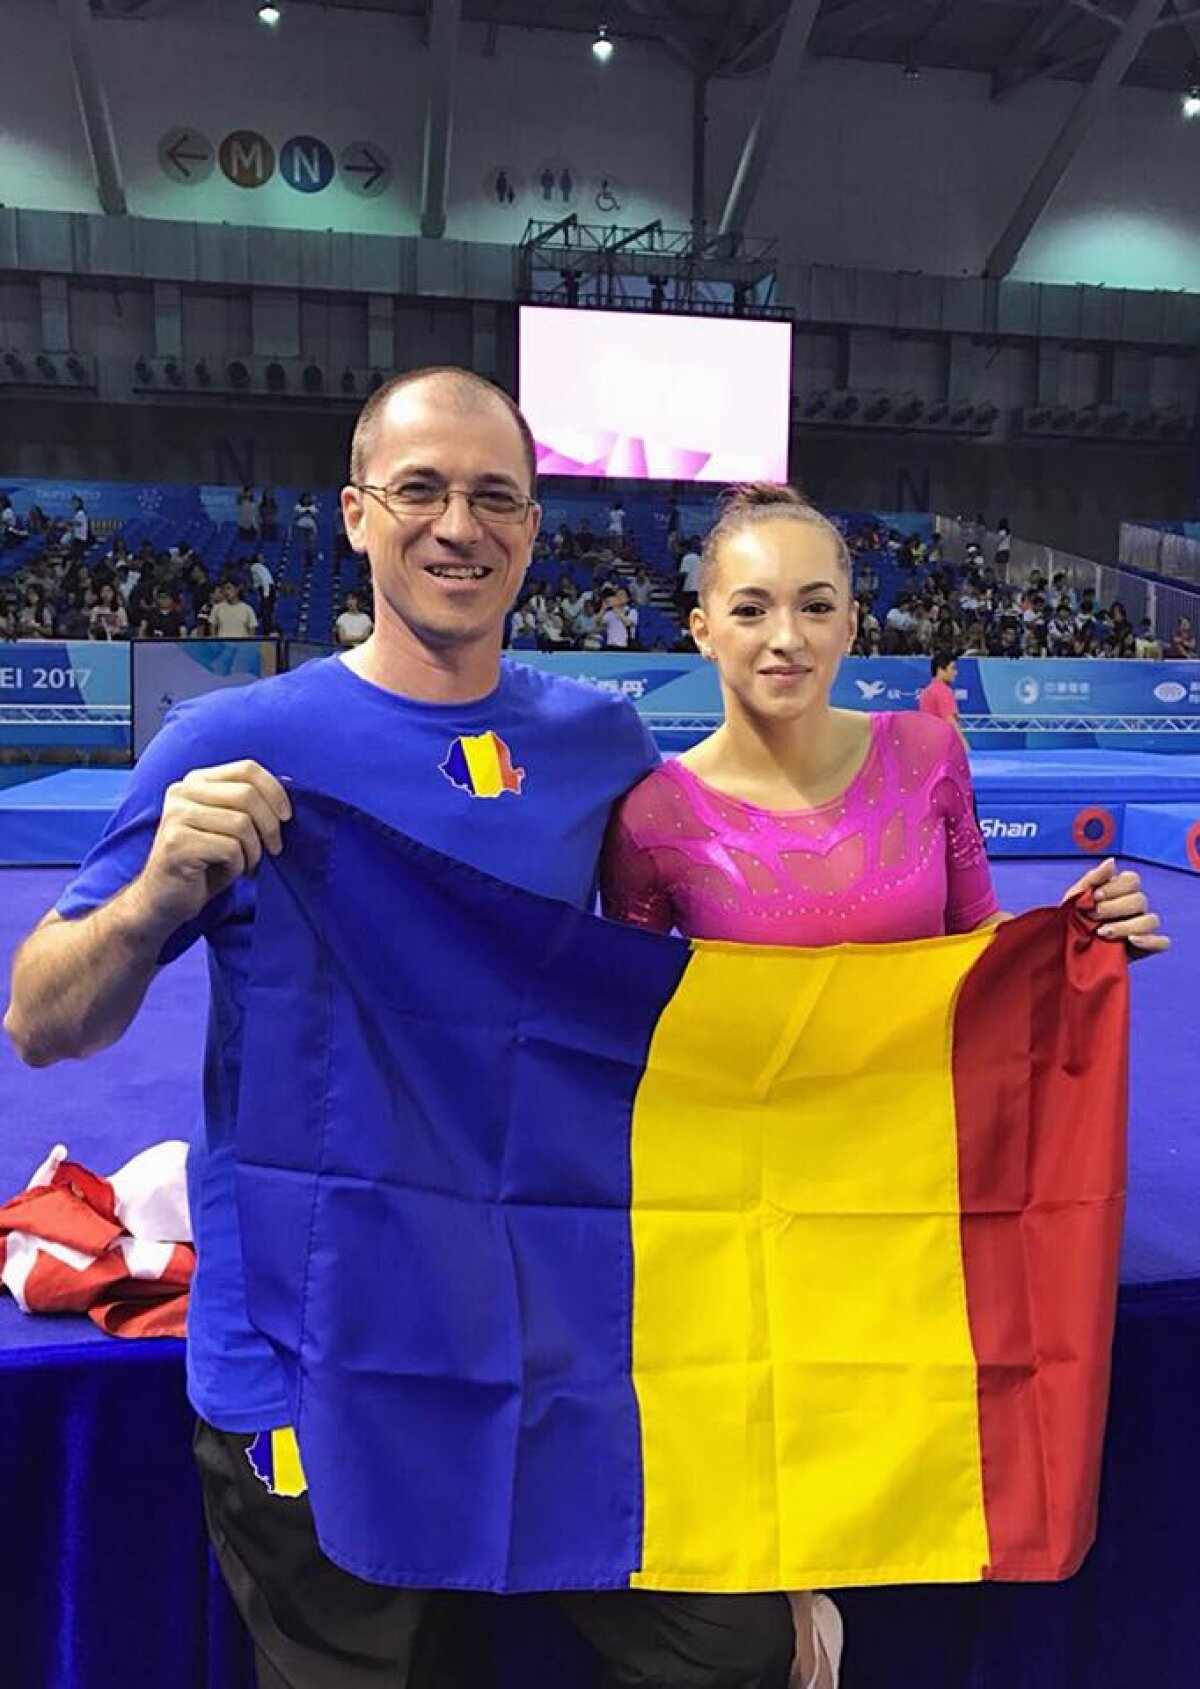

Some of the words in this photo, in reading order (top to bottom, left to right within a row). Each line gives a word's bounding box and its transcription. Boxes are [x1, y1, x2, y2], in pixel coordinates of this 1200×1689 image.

[231, 140, 263, 179] M
[293, 145, 320, 182] N
[217, 439, 254, 483] N
[897, 467, 930, 512] N
[0, 668, 22, 689] EI
[32, 667, 92, 689] 2017
[980, 818, 1038, 838] Shan
